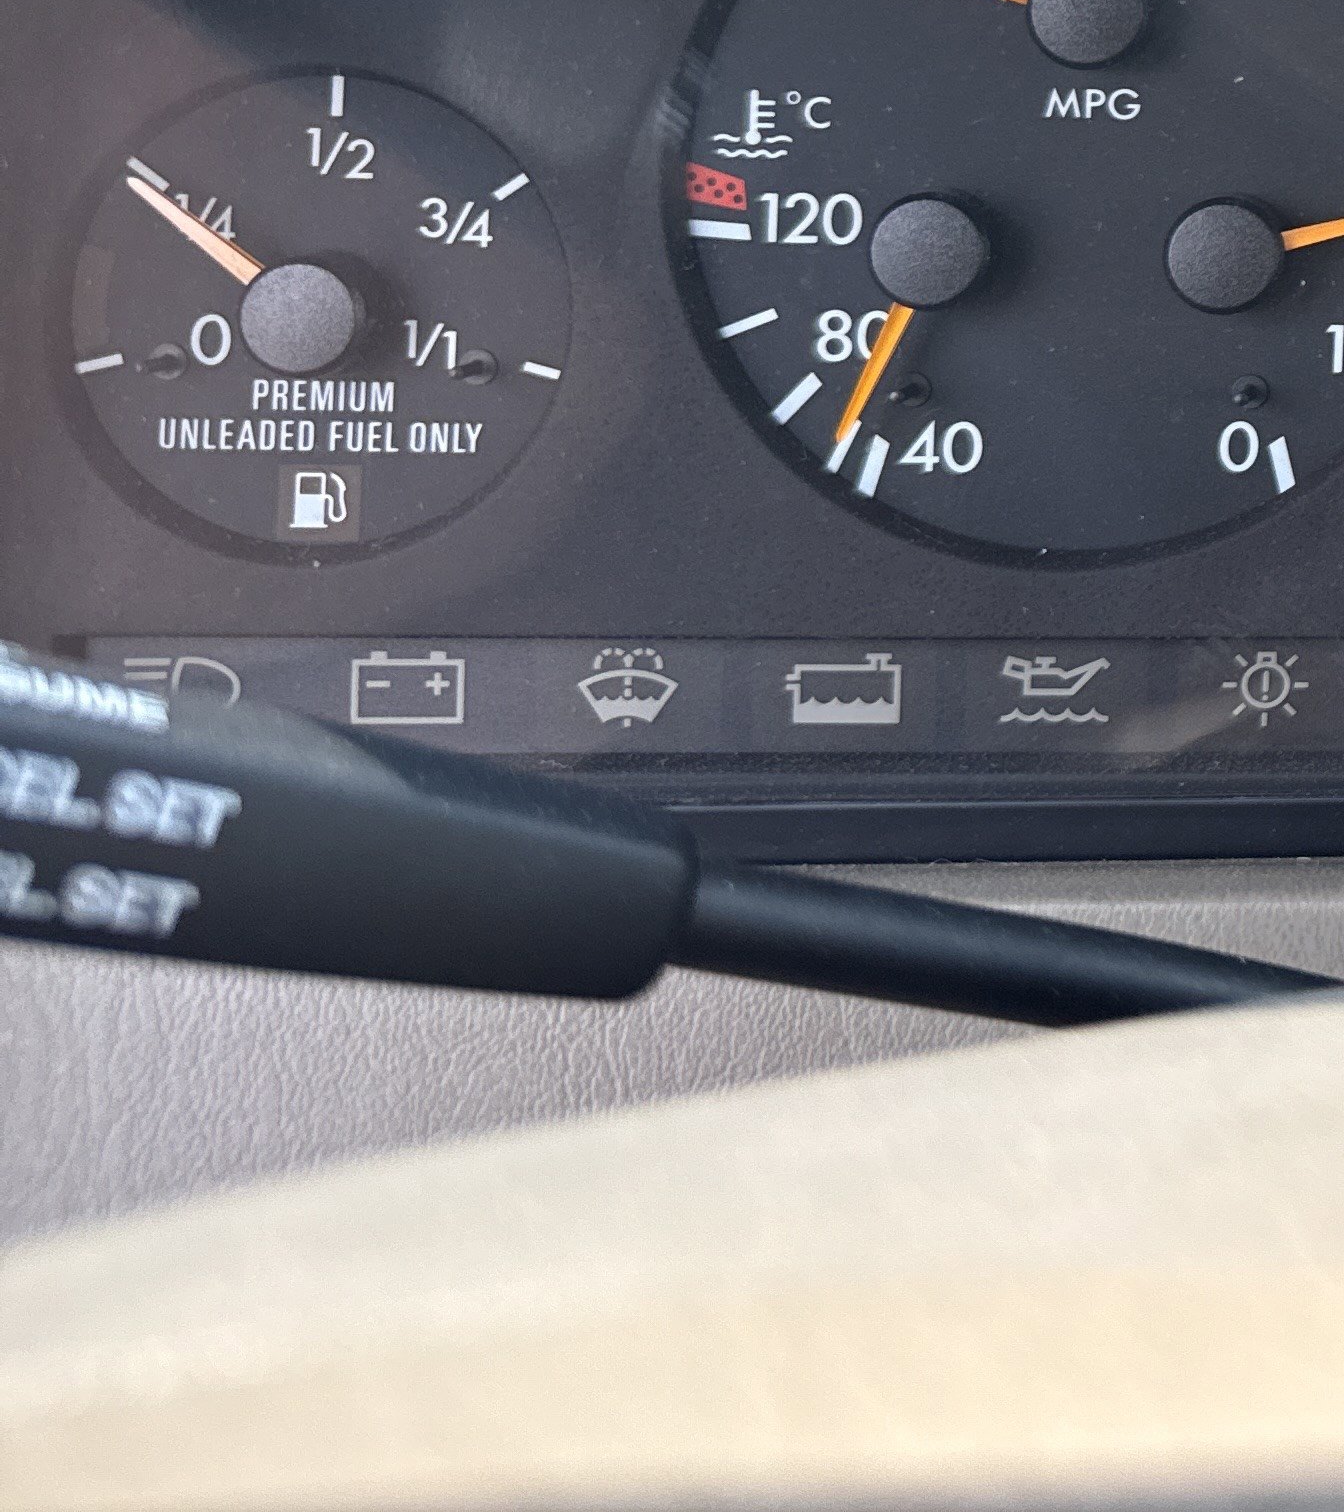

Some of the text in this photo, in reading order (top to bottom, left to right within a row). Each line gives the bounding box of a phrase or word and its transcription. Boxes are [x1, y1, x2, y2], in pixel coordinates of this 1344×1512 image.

[1042, 87, 1143, 122] MPG
[305, 126, 377, 181] 1/2
[418, 197, 495, 249] 3/4
[758, 192, 863, 246] 120
[189, 313, 232, 366] 0
[403, 318, 459, 372] 1/1
[815, 309, 893, 364] 80
[251, 379, 396, 413] PREMIUM
[158, 418, 483, 455] UNLEADED FUEL ONLY
[899, 420, 984, 474] 40
[1218, 421, 1260, 474] 0
